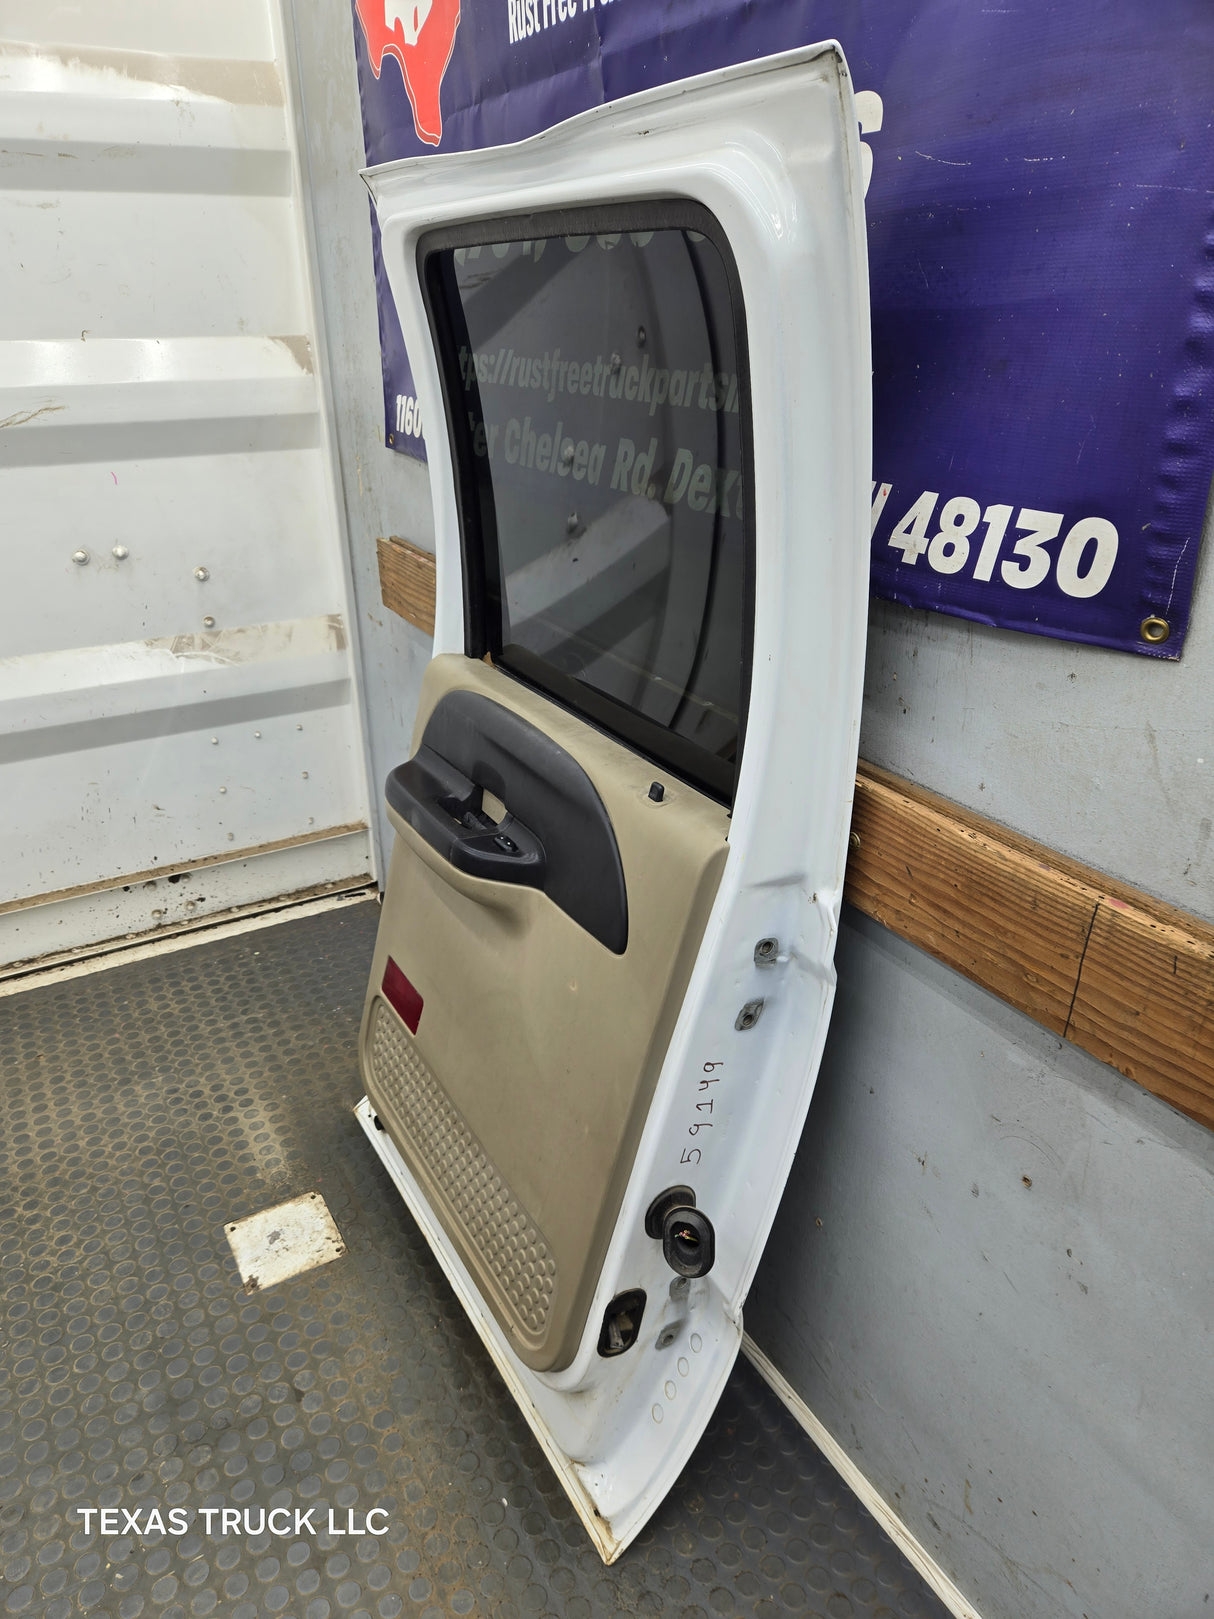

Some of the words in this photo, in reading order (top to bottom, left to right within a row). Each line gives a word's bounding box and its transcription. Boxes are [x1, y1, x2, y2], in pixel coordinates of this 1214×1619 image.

[396, 394, 425, 439] 1160
[504, 415, 607, 486] Chelsea
[610, 437, 659, 499] Rd.
[887, 490, 1119, 599] 48130
[680, 1062, 724, 1165] 59149
